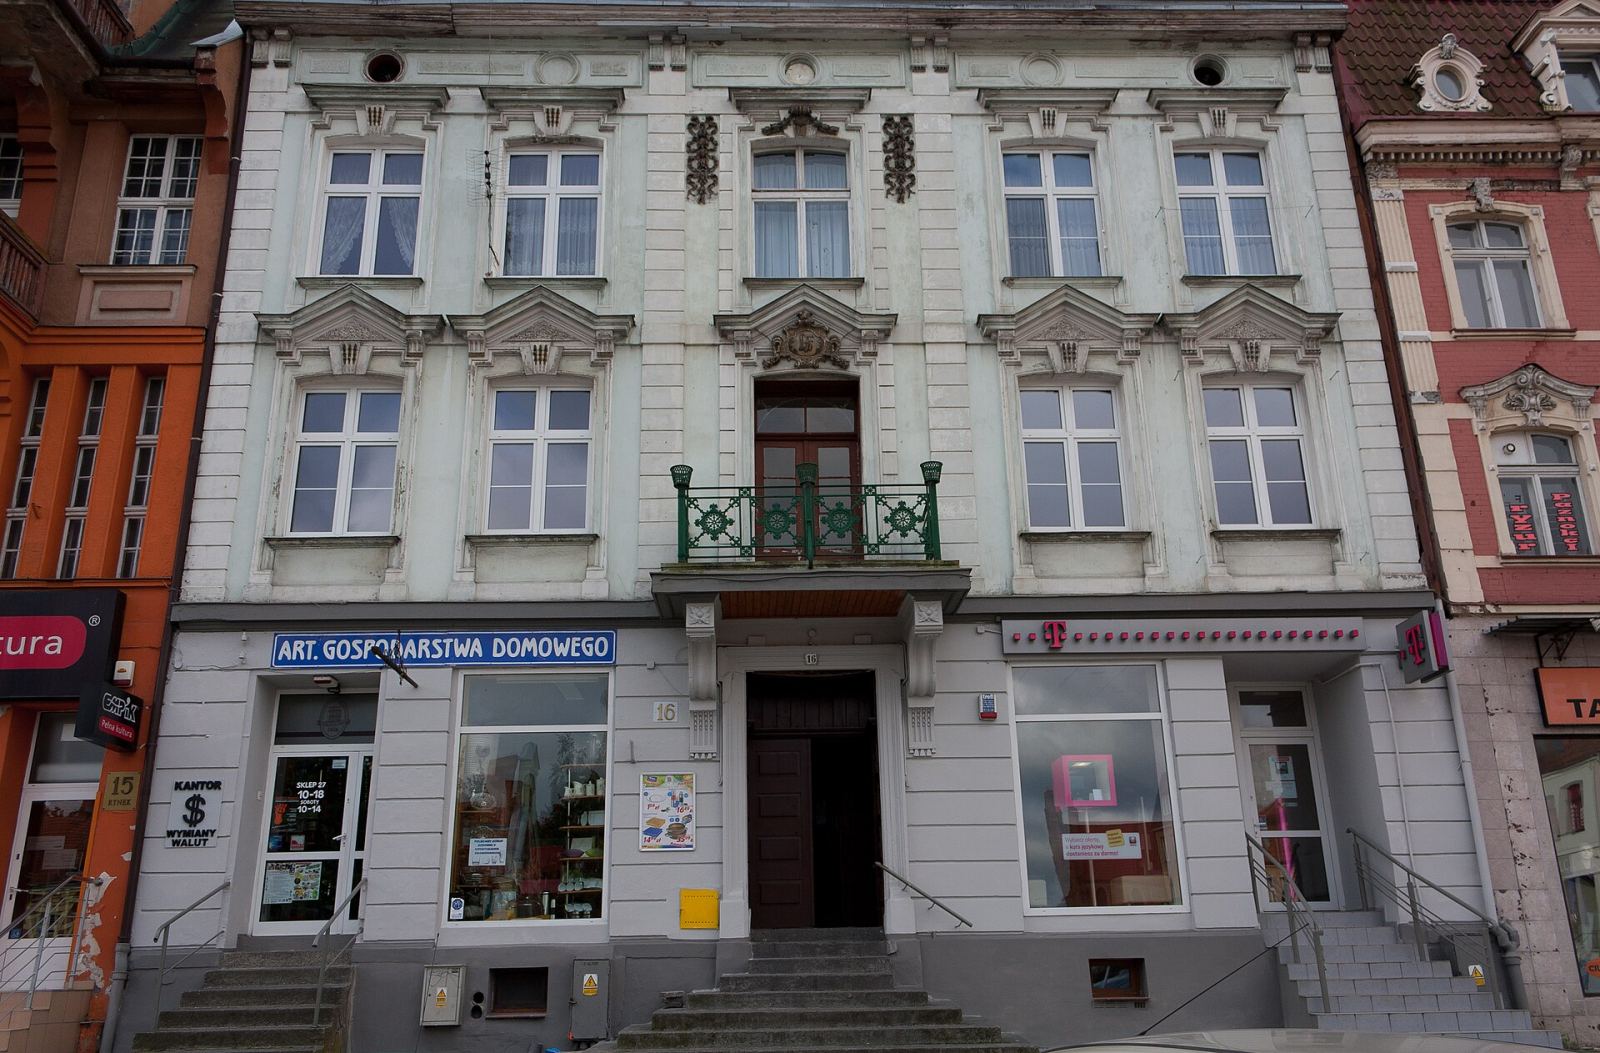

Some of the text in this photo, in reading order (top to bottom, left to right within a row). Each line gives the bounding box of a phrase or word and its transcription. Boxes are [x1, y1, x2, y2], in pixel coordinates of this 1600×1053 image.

[1044, 621, 1067, 648] T
[278, 640, 319, 660] ART.
[492, 636, 609, 658] DOMOWEGO
[1404, 624, 1425, 666] T
[805, 653, 818, 665] 16
[657, 703, 676, 721] 16
[111, 776, 134, 796] 15
[174, 780, 222, 791] KANTOR
[166, 829, 217, 839] WYMIANY
[171, 838, 209, 847] WALUT
